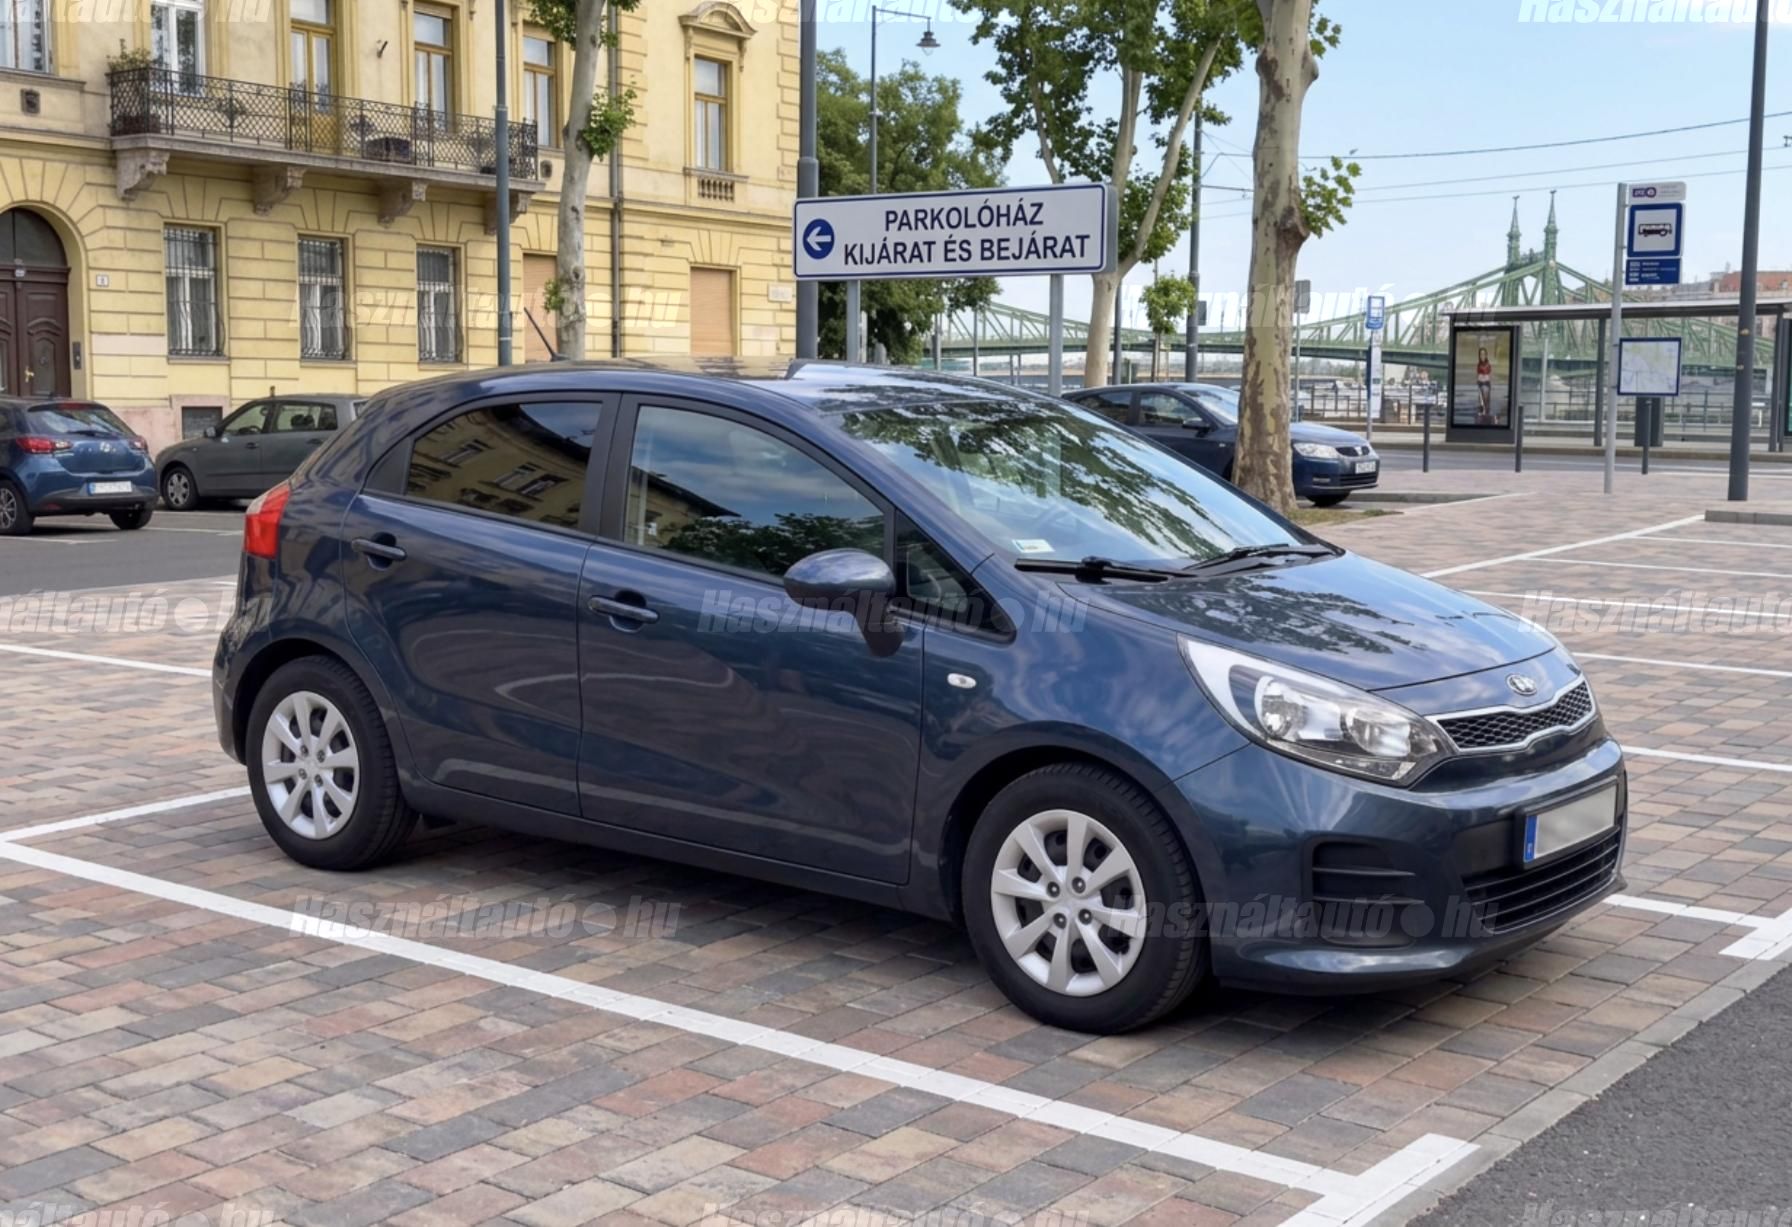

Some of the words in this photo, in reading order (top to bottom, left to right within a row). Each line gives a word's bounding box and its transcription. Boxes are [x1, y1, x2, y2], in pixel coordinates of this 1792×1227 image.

[885, 198, 1044, 231] PARKOLÓHÁZ
[844, 236, 937, 265] KIJÁRAT
[943, 234, 972, 263] ÉS
[980, 231, 1090, 261] BEJÁRAT
